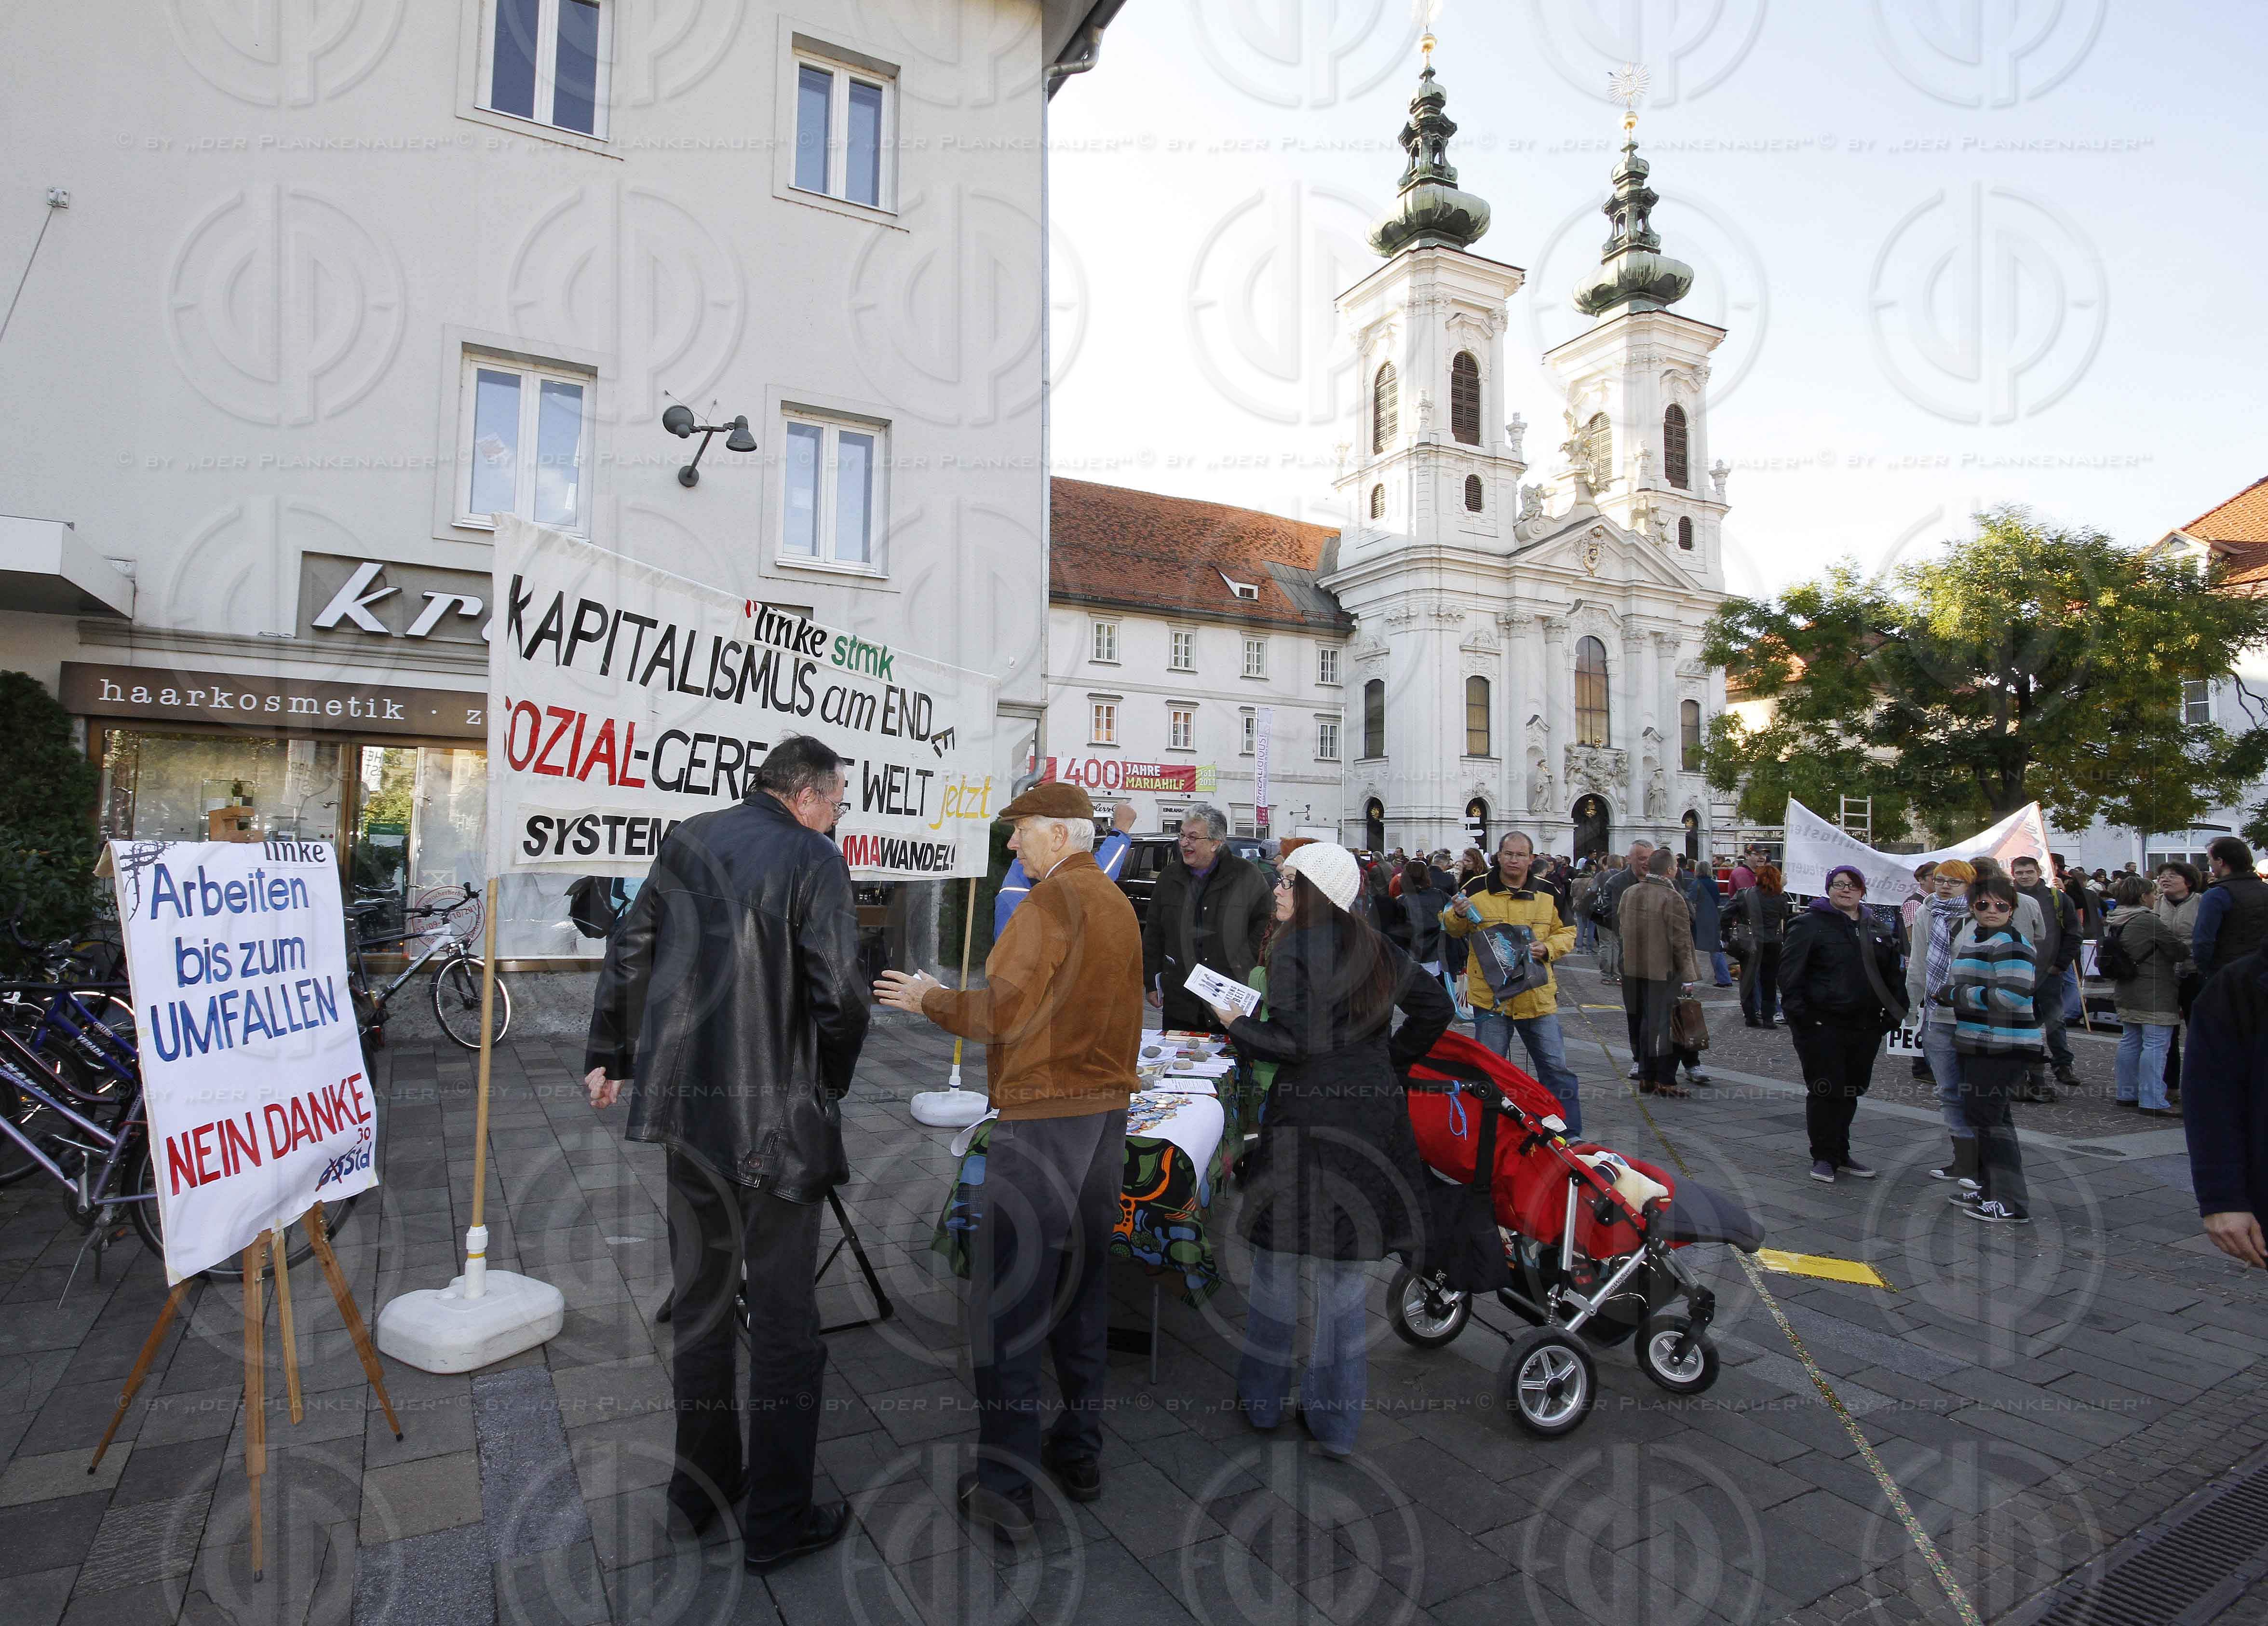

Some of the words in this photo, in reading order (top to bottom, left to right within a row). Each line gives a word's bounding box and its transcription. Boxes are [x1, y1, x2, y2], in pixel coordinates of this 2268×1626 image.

[311, 562, 491, 642] kr
[507, 574, 817, 717] KAPITALISMUS
[821, 685, 876, 732] am
[881, 684, 955, 759] ENDE
[755, 604, 827, 657] linke
[831, 635, 894, 682] stmk
[98, 678, 405, 720] haarkosmetik
[863, 760, 934, 817] WELT
[929, 774, 992, 830] jetzt
[1063, 759, 1120, 789] 400
[1125, 777, 1185, 790] MARIAHILF
[1126, 763, 1161, 777] JAHRE
[1199, 778, 1216, 786] 2011
[150, 863, 310, 920] Arbeiten
[175, 936, 233, 988] bis
[239, 936, 306, 978] zum
[150, 976, 339, 1062] UMFALLEN
[166, 1111, 262, 1196] NEIN
[263, 1072, 371, 1160] DANKE
[357, 1126, 371, 1144] 30
